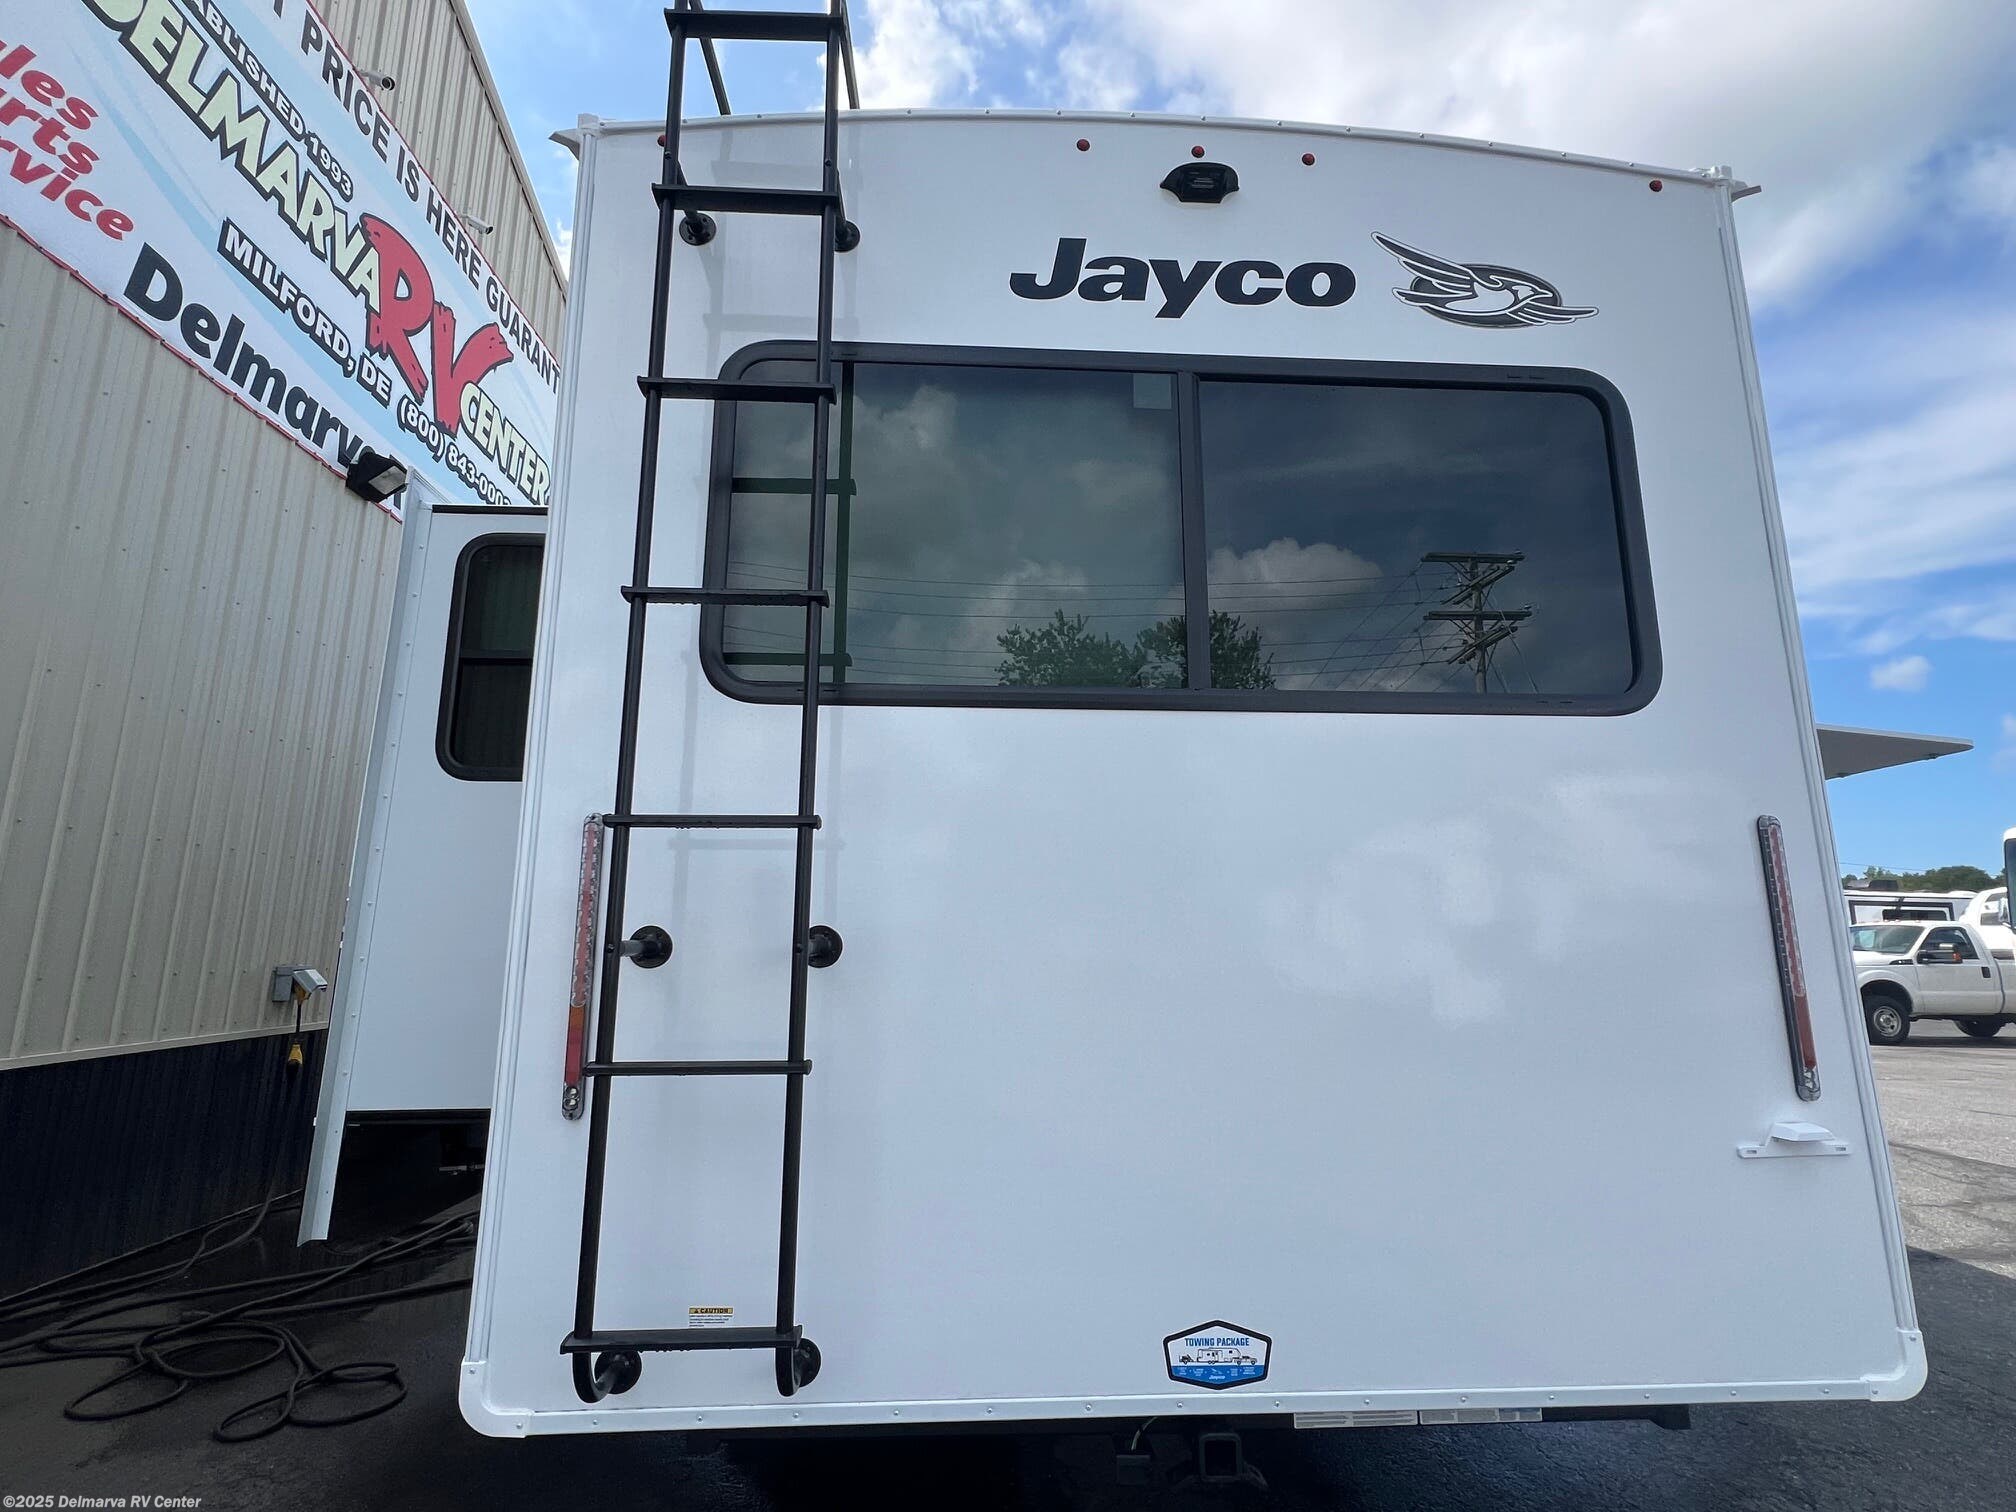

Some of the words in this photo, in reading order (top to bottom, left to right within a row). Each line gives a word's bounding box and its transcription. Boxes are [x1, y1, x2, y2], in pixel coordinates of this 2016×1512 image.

[0, 40, 99, 130] les
[0, 87, 100, 174] rts
[301, 9, 391, 164] PRICE
[396, 146, 421, 202] IS
[426, 187, 482, 290] HERE
[1009, 237, 1356, 318] Jayco
[222, 225, 356, 374] MILFORD,
[361, 355, 392, 403] DE
[398, 395, 446, 460] (800)
[360, 213, 514, 441] RV
[1184, 1338, 1215, 1347] TOWING
[1217, 1338, 1250, 1347] PACKAGE
